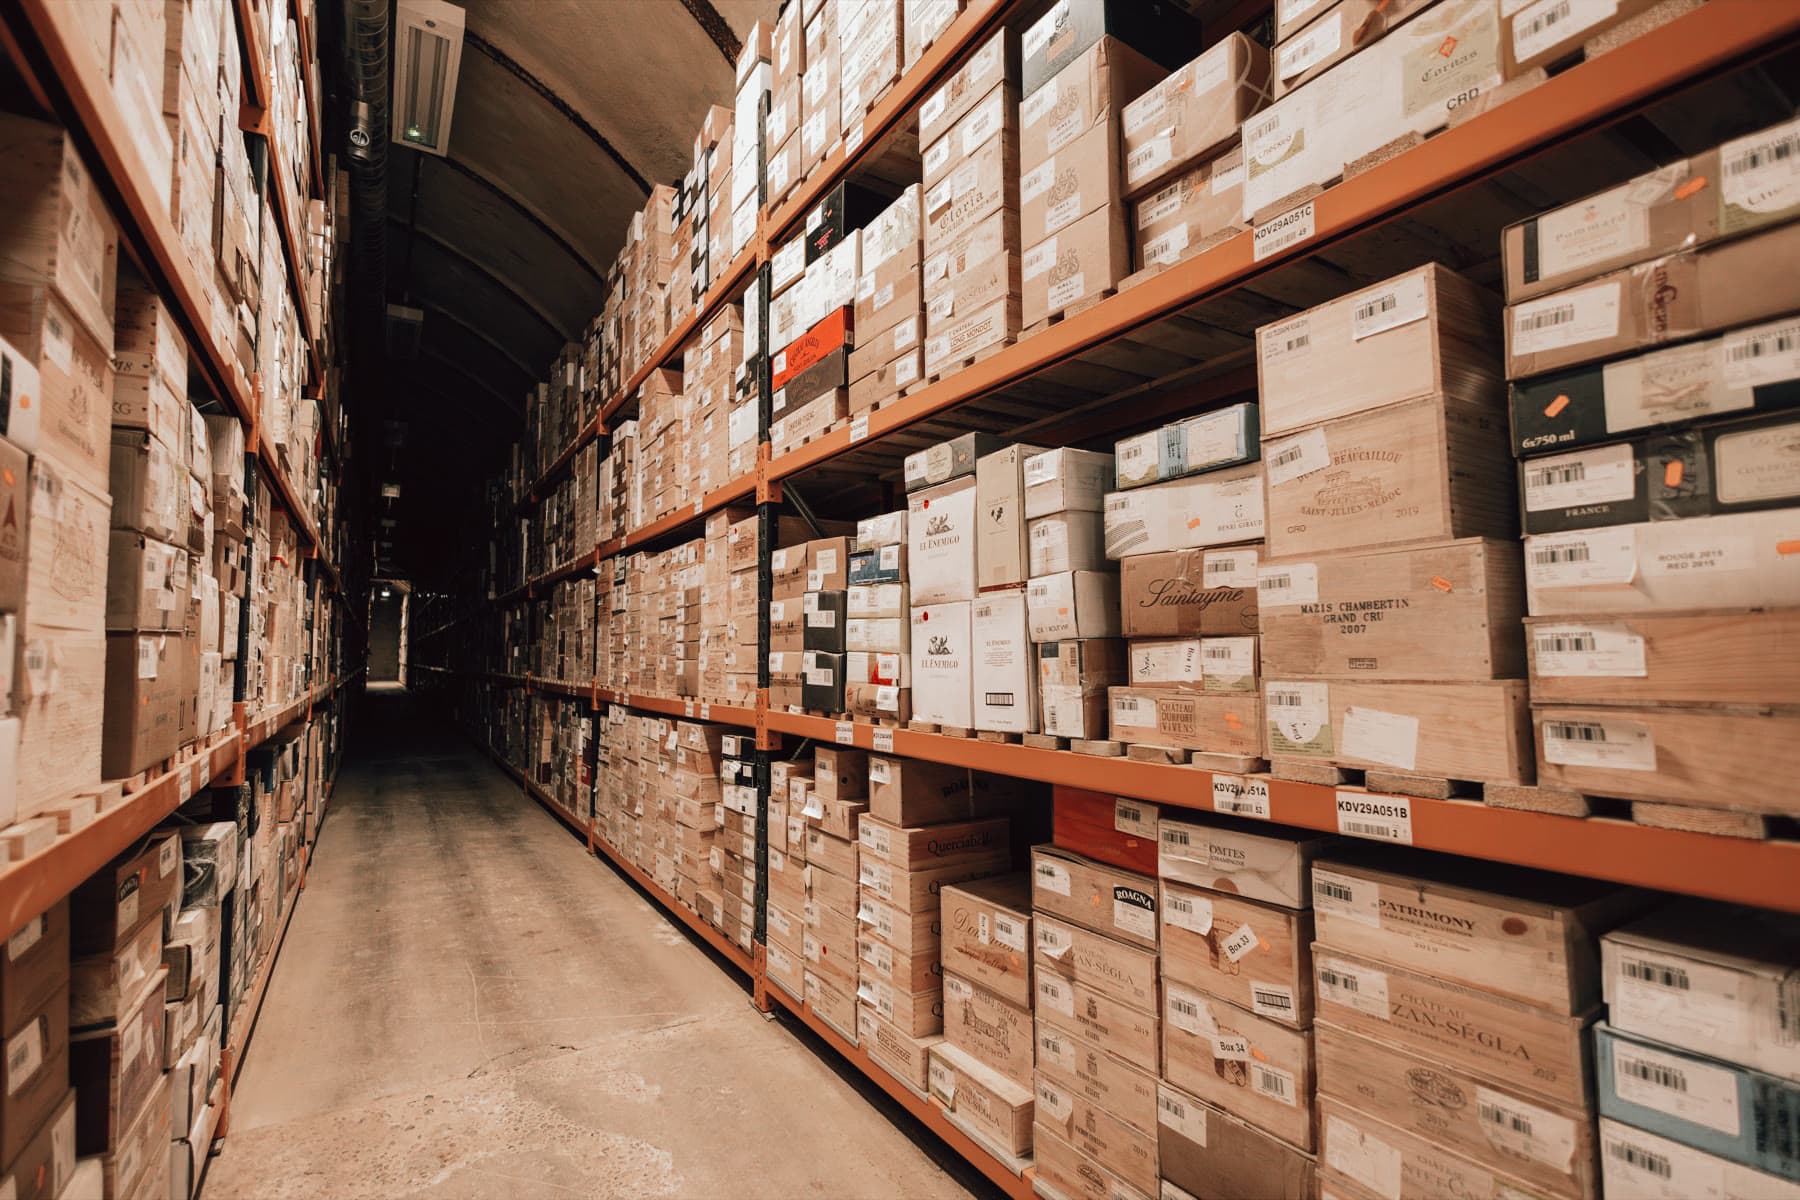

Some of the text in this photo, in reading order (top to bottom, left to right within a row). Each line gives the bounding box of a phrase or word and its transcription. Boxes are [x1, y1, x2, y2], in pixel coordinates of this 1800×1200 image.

[1446, 87, 1480, 111] CRD
[1254, 206, 1312, 241] KDV29A051C
[1522, 429, 1576, 449] 6x750 ml
[1334, 449, 1403, 465] BEAUCAILLOU
[1565, 505, 1610, 517] FRANCE
[928, 535, 961, 550] ENEMIGO
[1139, 578, 1245, 611] Saintayme
[1301, 598, 1410, 614] MAZIS CHAMBERTIN
[1323, 612, 1384, 624] GRAND CRU
[1340, 625, 1367, 634] 2007
[1162, 722, 1194, 733] VIVENS
[1214, 782, 1267, 797] KDV29A51A
[1255, 806, 1263, 815] 52
[1338, 800, 1408, 819] KDV29A051B
[1210, 844, 1246, 860] OMTES
[1116, 889, 1152, 910] ROAGNA
[1379, 898, 1476, 930] PATRIMONY
[1227, 935, 1250, 955] Box 33
[1391, 1001, 1531, 1061] ZAN-SÉGLA
[1219, 1041, 1245, 1053] Box 34
